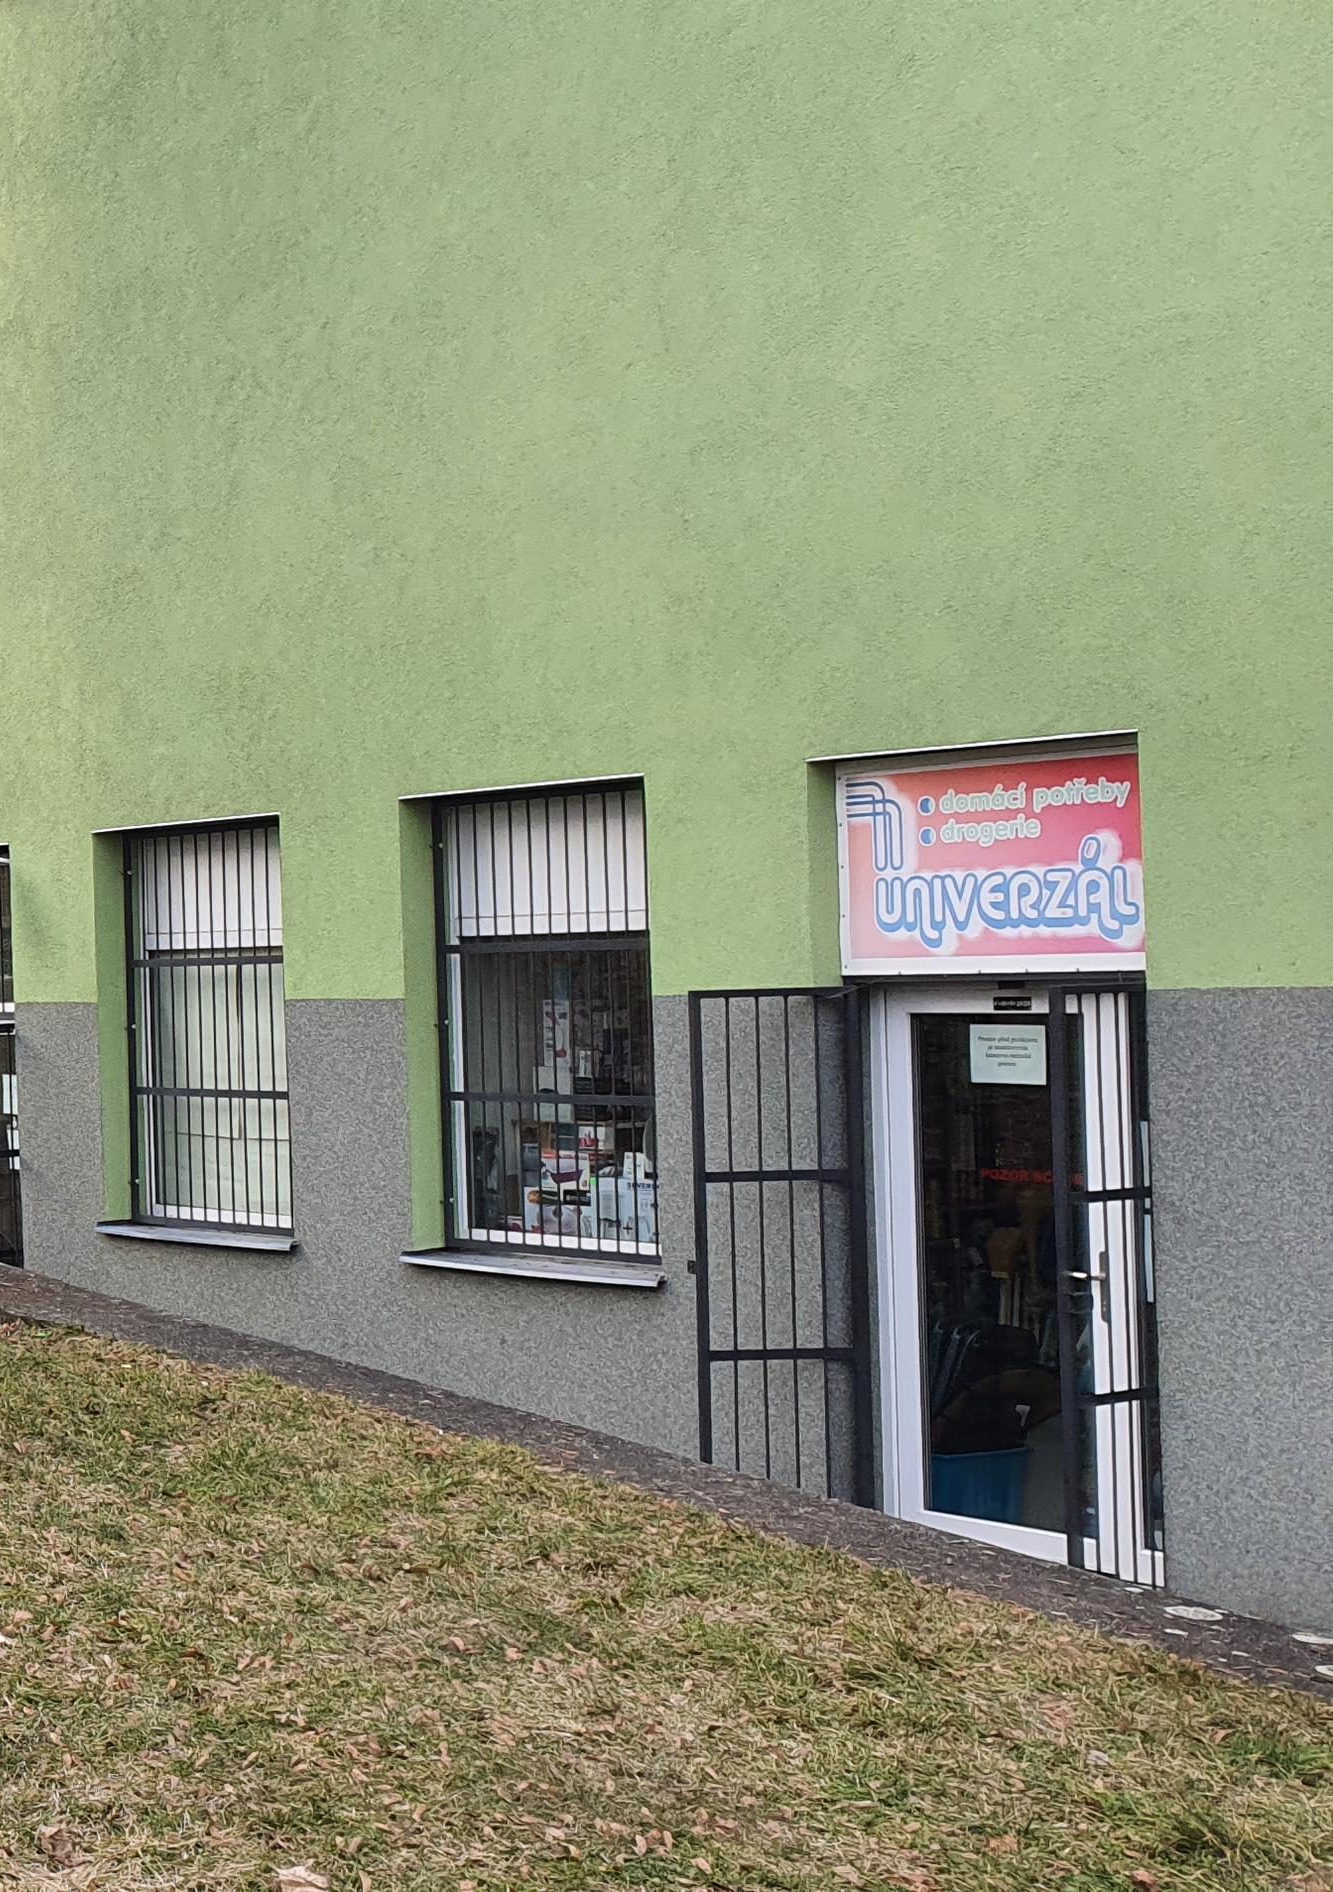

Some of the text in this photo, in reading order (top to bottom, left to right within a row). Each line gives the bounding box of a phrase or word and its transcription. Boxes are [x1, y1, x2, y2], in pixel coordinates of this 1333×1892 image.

[939, 777, 1131, 814] domácí potřeby
[941, 813, 1041, 846] drogerie
[876, 835, 1140, 949] UNIVERZÁL
